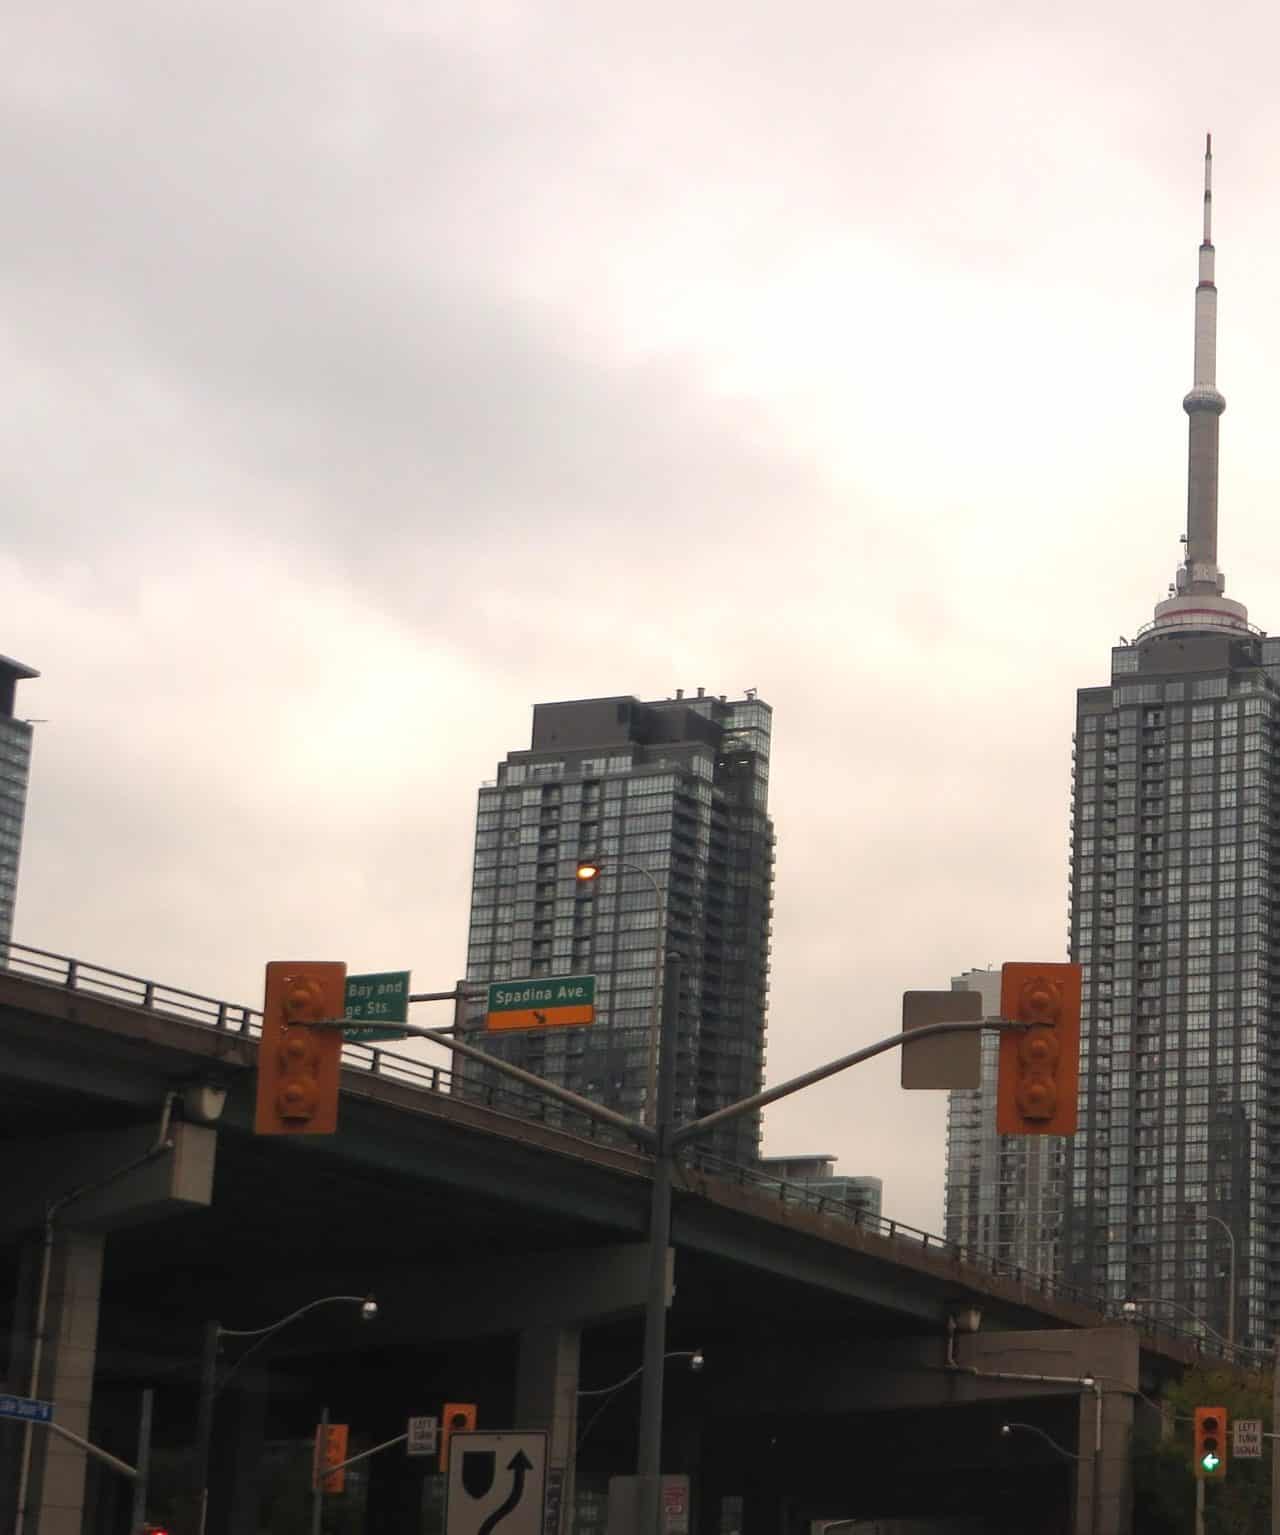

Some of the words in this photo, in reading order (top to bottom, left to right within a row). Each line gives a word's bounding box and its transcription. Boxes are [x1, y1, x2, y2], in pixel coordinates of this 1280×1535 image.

[349, 983, 373, 999] Bay
[377, 981, 403, 994] and
[495, 988, 553, 1005] Spadina
[556, 985, 588, 999] Ave.
